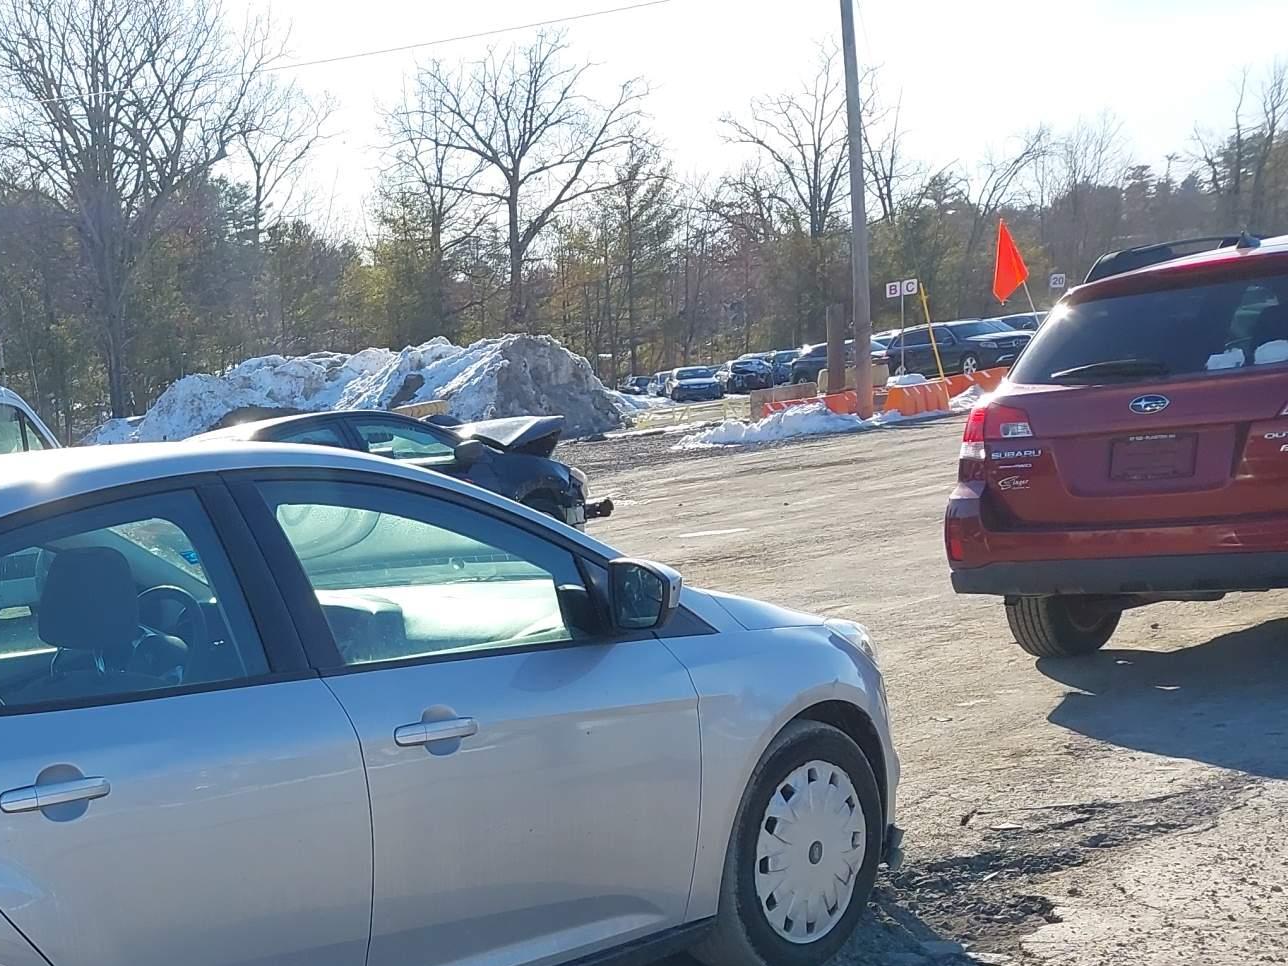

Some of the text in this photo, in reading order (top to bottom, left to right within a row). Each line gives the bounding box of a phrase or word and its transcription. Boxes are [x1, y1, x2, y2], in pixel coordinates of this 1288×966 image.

[888, 284, 898, 295] B
[905, 281, 916, 293] C
[991, 449, 1042, 460] SUBARU
